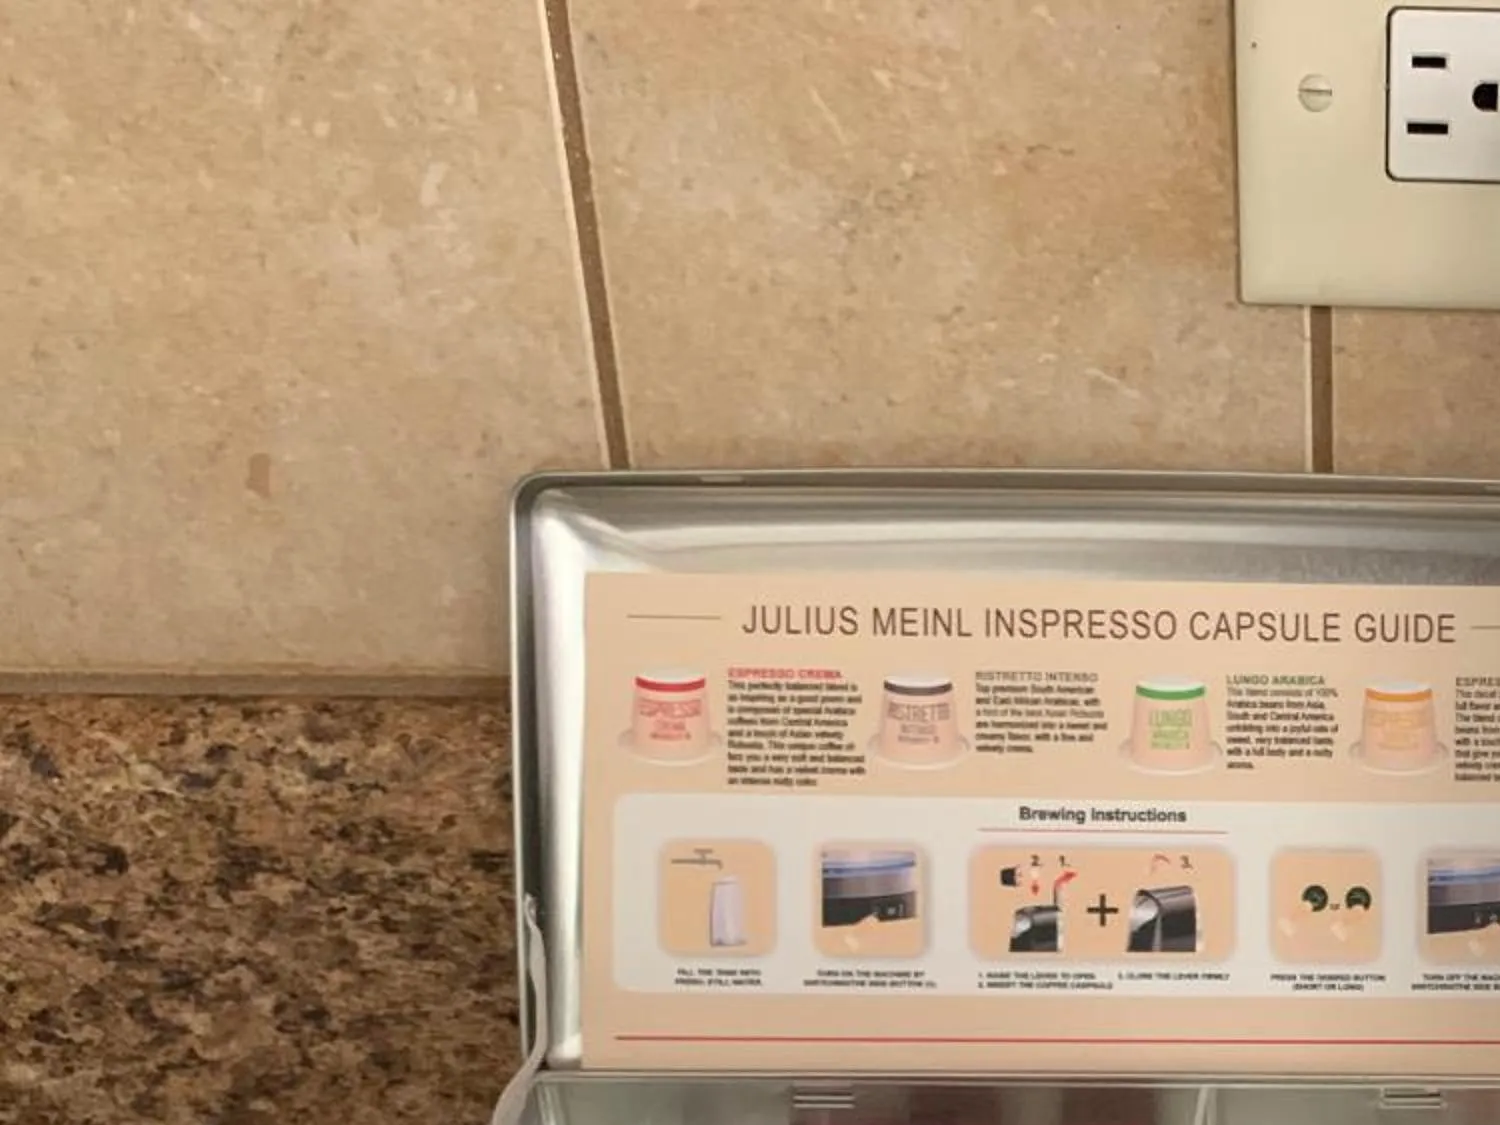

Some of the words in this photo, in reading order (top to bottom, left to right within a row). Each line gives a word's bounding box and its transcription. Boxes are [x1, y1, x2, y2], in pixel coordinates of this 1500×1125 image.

[743, 606, 859, 637] JULIUS
[873, 607, 973, 638] MEINL
[985, 608, 1178, 640] INSPRESSO
[1190, 611, 1341, 642] CAPSULE
[1355, 612, 1457, 643] GUIDE
[1019, 806, 1086, 824] Brewing
[1091, 807, 1187, 823] Instructions
